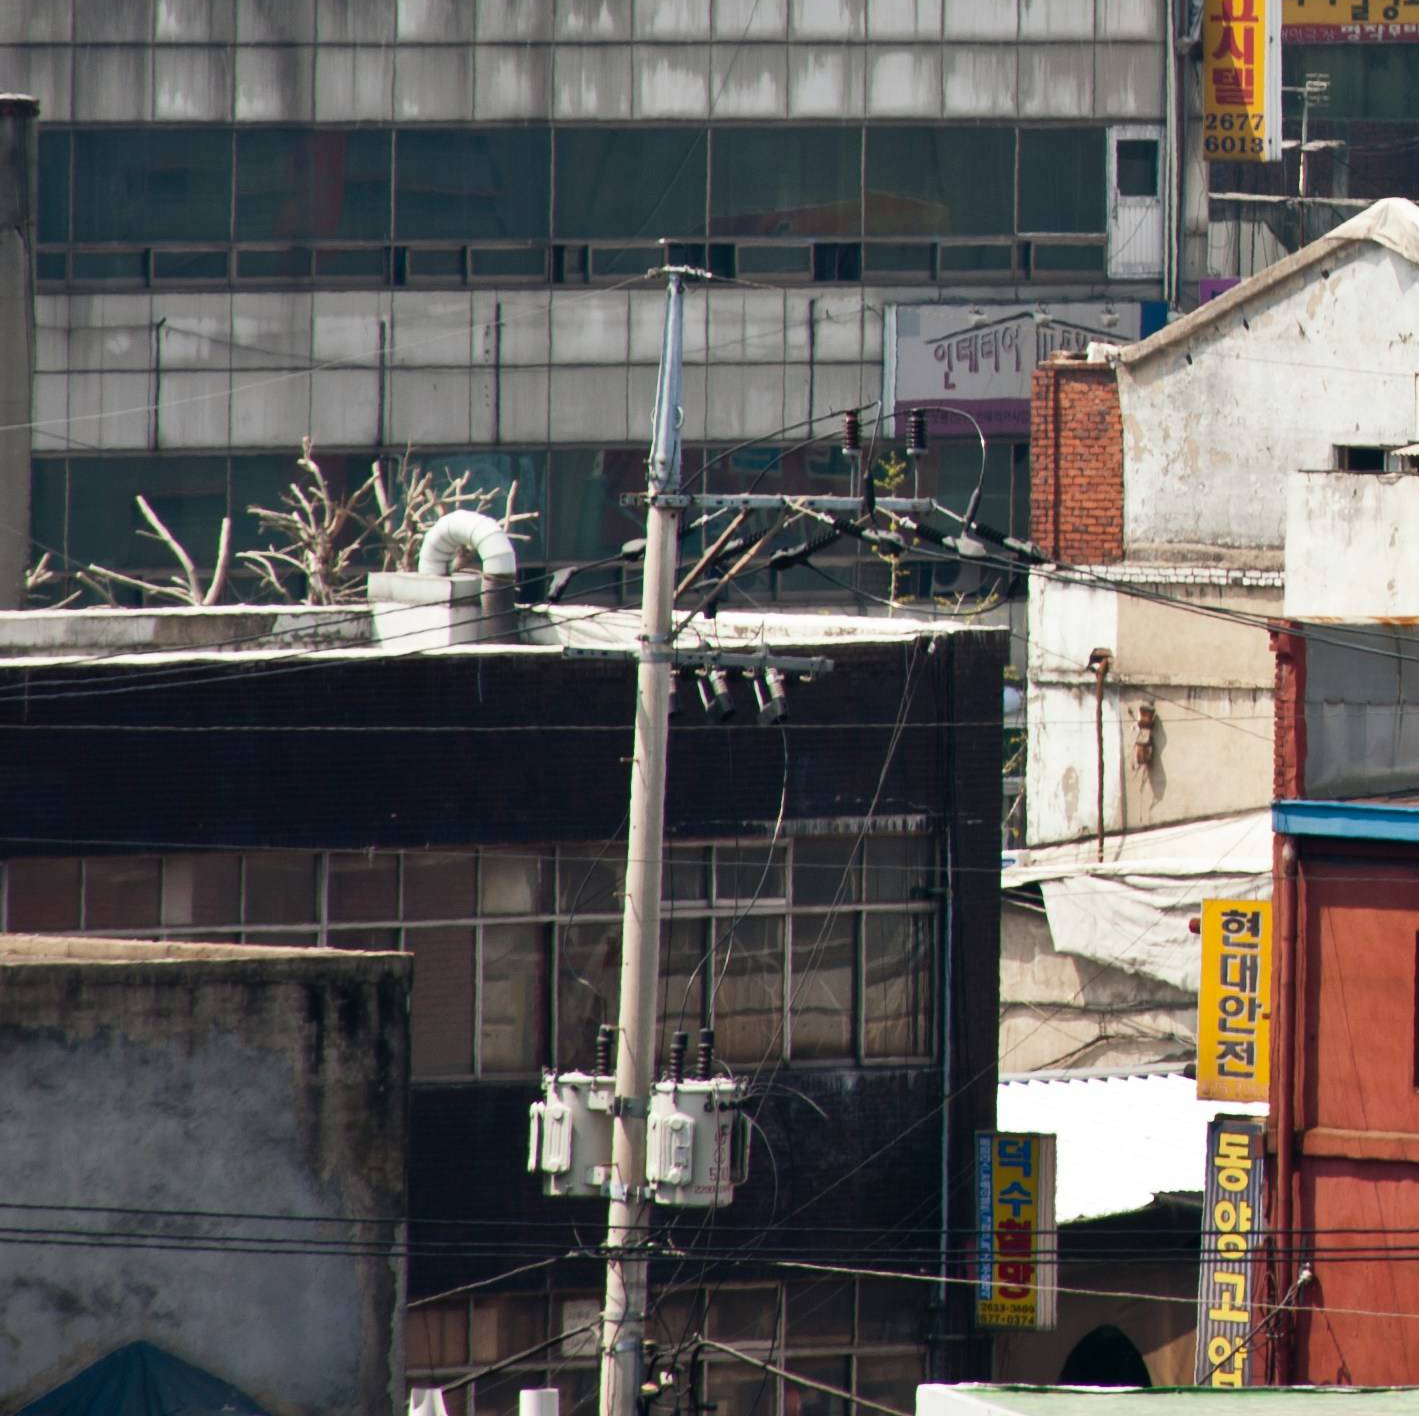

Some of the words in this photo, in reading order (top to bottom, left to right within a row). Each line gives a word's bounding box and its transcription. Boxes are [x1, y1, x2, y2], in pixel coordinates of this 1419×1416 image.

[1204, 113, 1263, 131] 2677
[934, 325, 1021, 391] 인테리어
[1216, 909, 1262, 1078] 현대안전
